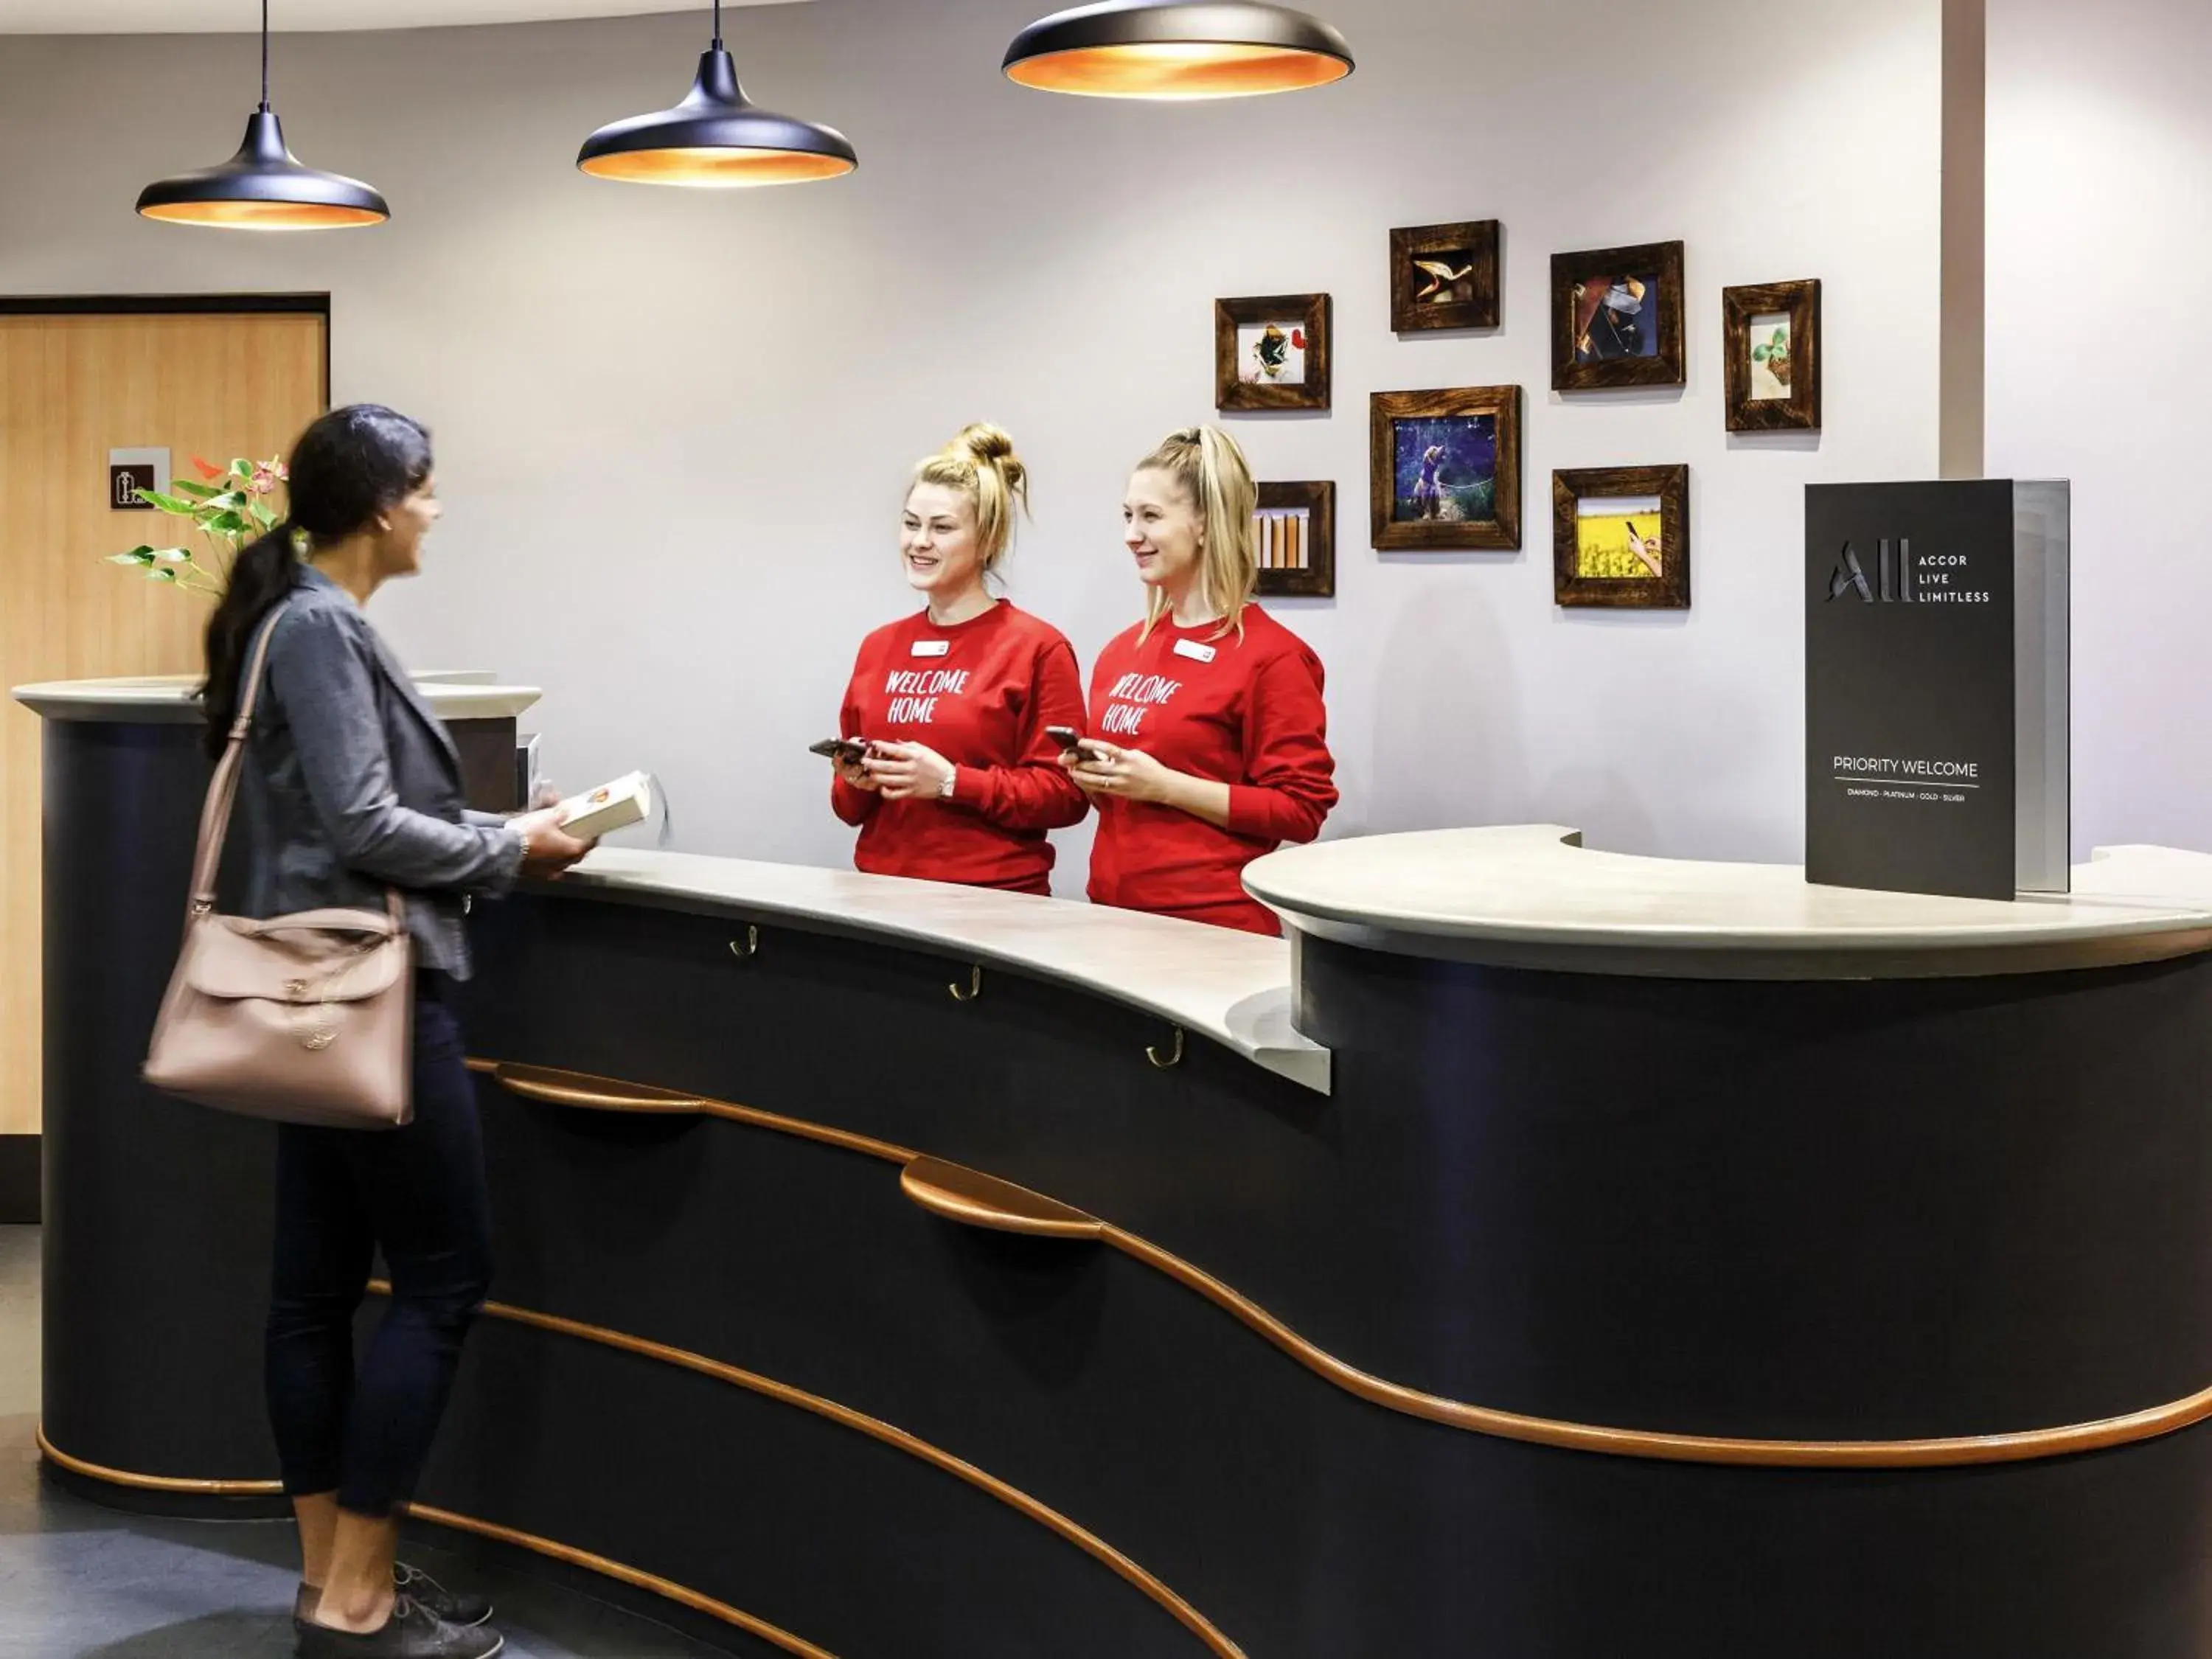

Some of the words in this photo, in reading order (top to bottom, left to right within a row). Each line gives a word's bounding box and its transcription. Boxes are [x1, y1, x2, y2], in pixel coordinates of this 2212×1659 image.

[1919, 555, 1967, 566] ACCOR
[1919, 574, 1950, 585] LIVE
[1919, 592, 1990, 603] LIMITLESS
[886, 669, 970, 695] WELCOME
[1109, 672, 1182, 704] WELCOME
[887, 697, 938, 723] HOME
[1102, 704, 1147, 735] HOME
[1833, 756, 1899, 773] PRIORITY
[1902, 760, 1979, 778] WELCOME
[1847, 788, 1879, 798] DIAMOND
[1882, 790, 1916, 799] PLATINUM
[1919, 793, 1938, 801] GOLD
[1943, 793, 1965, 802] SILVER
